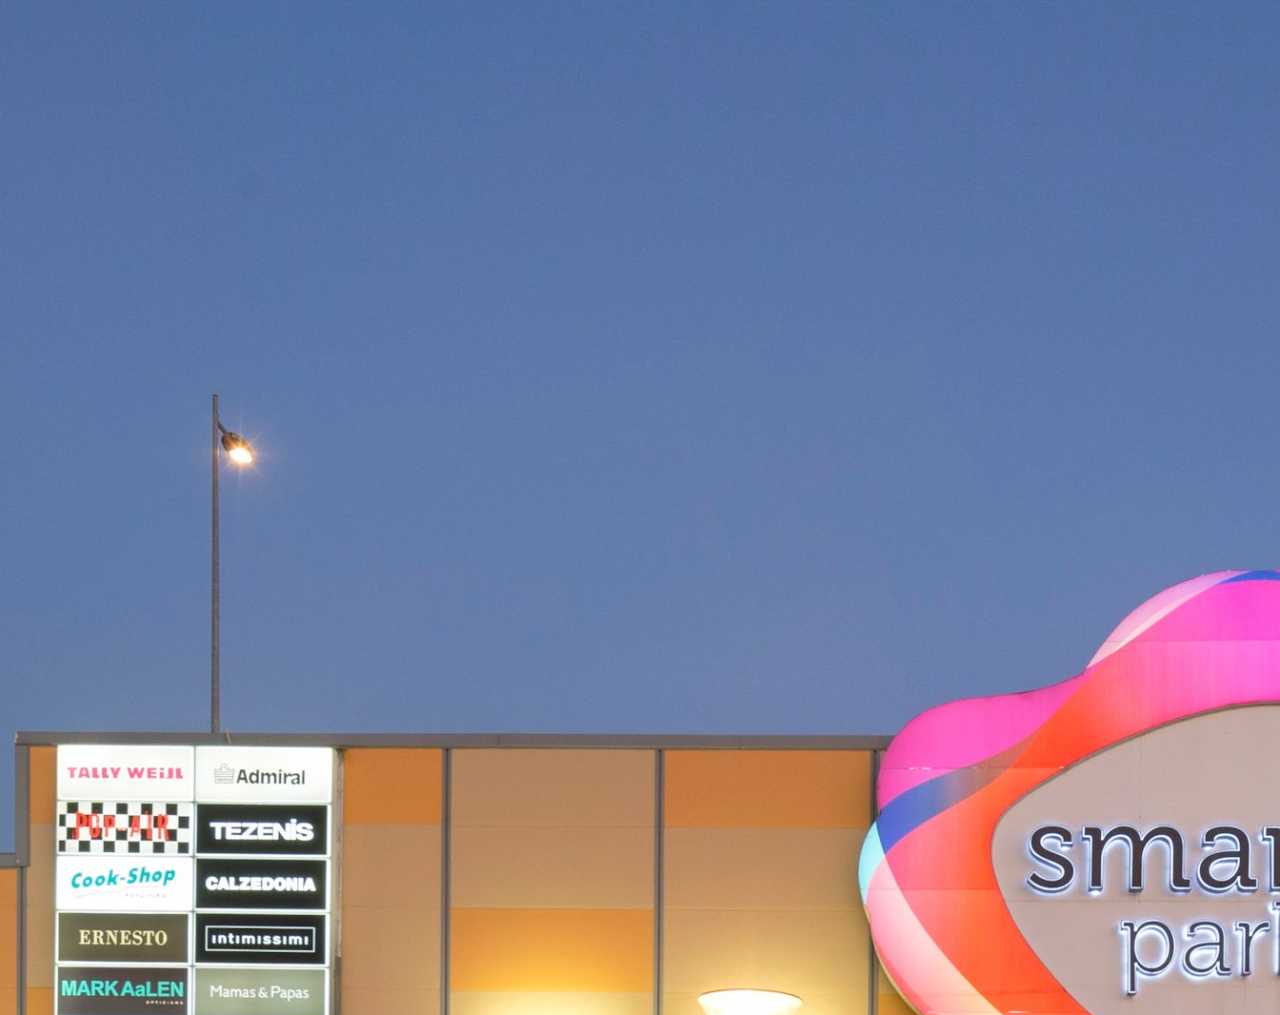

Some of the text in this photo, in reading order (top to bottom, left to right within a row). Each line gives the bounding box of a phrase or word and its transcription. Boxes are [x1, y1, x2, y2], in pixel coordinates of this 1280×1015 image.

[67, 767, 121, 779] TALLY
[236, 769, 306, 785] Admiral
[71, 865, 176, 889] Cook-Shop
[205, 876, 317, 892] CALZEDONIA
[79, 929, 168, 946] ERNESTO
[212, 933, 309, 946] intimissimi
[61, 980, 184, 998] MARK AaLEN
[210, 985, 310, 1001] Mamas & Papas
